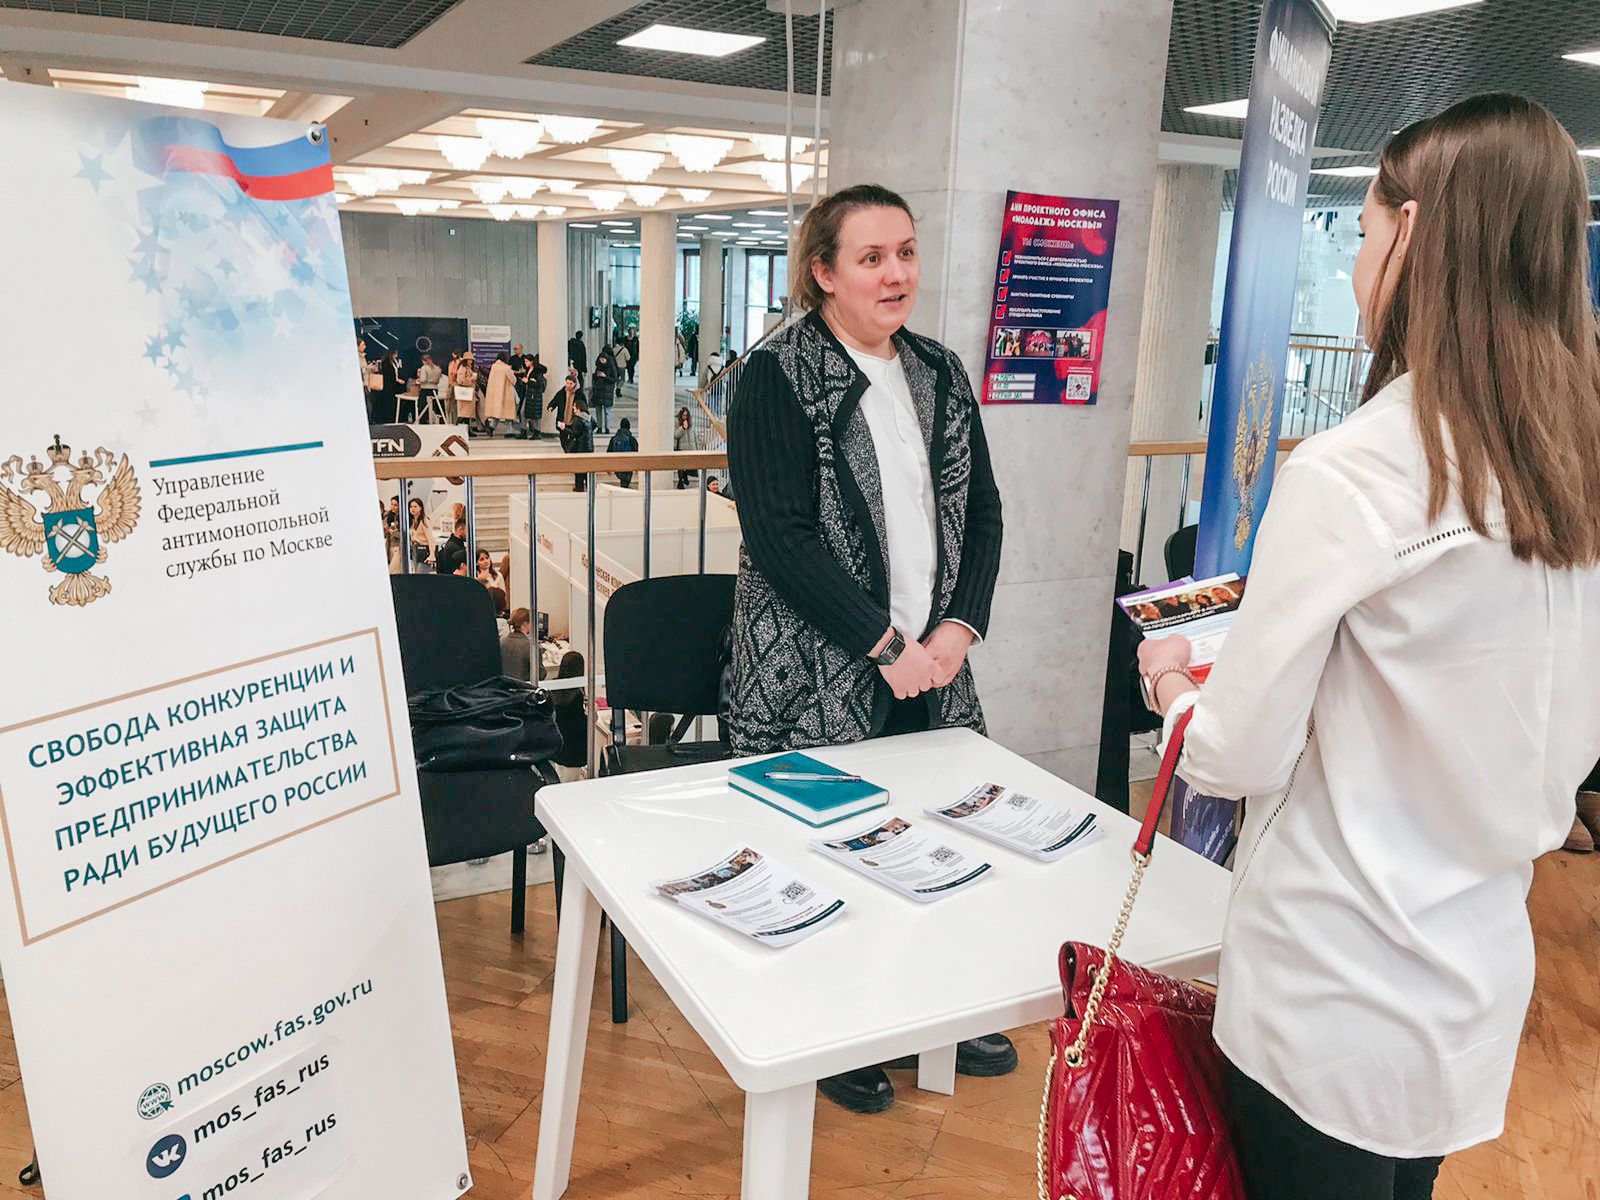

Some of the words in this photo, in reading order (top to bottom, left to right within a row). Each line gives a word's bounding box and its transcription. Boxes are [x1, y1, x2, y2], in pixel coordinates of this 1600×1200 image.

[1269, 96, 1308, 158] РАЗВЕДКА
[1023, 204, 1070, 216] ПРОЕКТНОГО
[1072, 209, 1106, 219] ОФИСА
[1265, 160, 1298, 207] РОССИИ
[1057, 220, 1102, 229] МОСКВЫ»
[152, 468, 265, 496] Управление
[157, 490, 281, 524] Федеральной
[161, 506, 330, 552] антимонопольной
[165, 550, 238, 580] службы
[243, 545, 265, 562] по
[270, 532, 334, 558] Москве
[28, 712, 160, 769] СВОБОДА
[167, 659, 335, 728] КОНКУРЕНЦИИ
[340, 655, 355, 676] И
[55, 724, 249, 806] ЭФФЕКТИВНАЯ
[256, 694, 348, 740] ЗАЩИТА
[54, 728, 358, 851] ПРЕДПРИНИМАТЕЛЬСТВА
[62, 844, 140, 893] РАДИ
[147, 794, 278, 860] БУДУЩЕГО
[284, 760, 367, 808] РОССИИ
[176, 978, 373, 1096] moscow.fas.gov.ru
[192, 1052, 330, 1144] mos_fas_rus
[202, 1112, 338, 1200] mos_fas_rus
